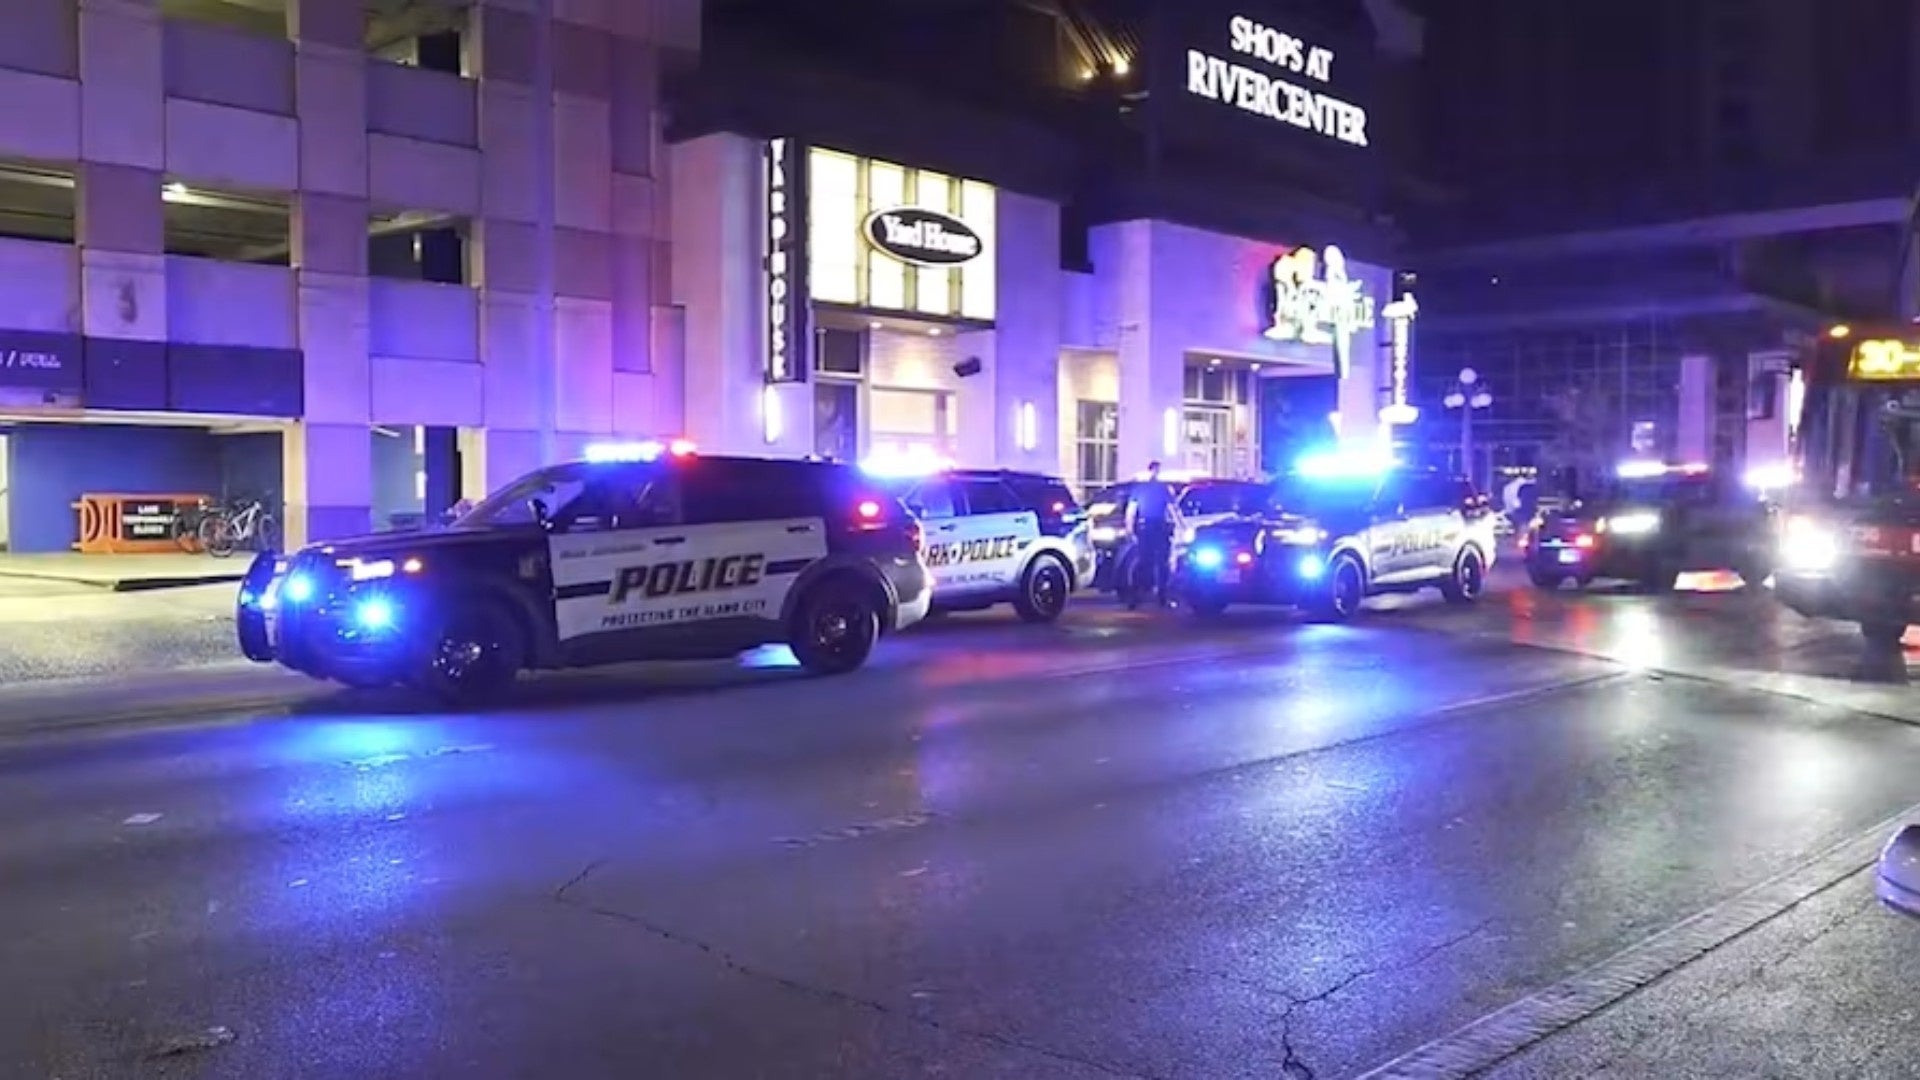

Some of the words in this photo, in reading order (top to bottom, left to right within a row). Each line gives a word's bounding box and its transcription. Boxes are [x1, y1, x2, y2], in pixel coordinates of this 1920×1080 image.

[1229, 15, 1304, 72] SHOPS
[1305, 45, 1334, 82] AT
[1187, 49, 1368, 146] RIVERCENTER
[958, 534, 1017, 563] POLICE
[608, 553, 765, 606] POLICE
